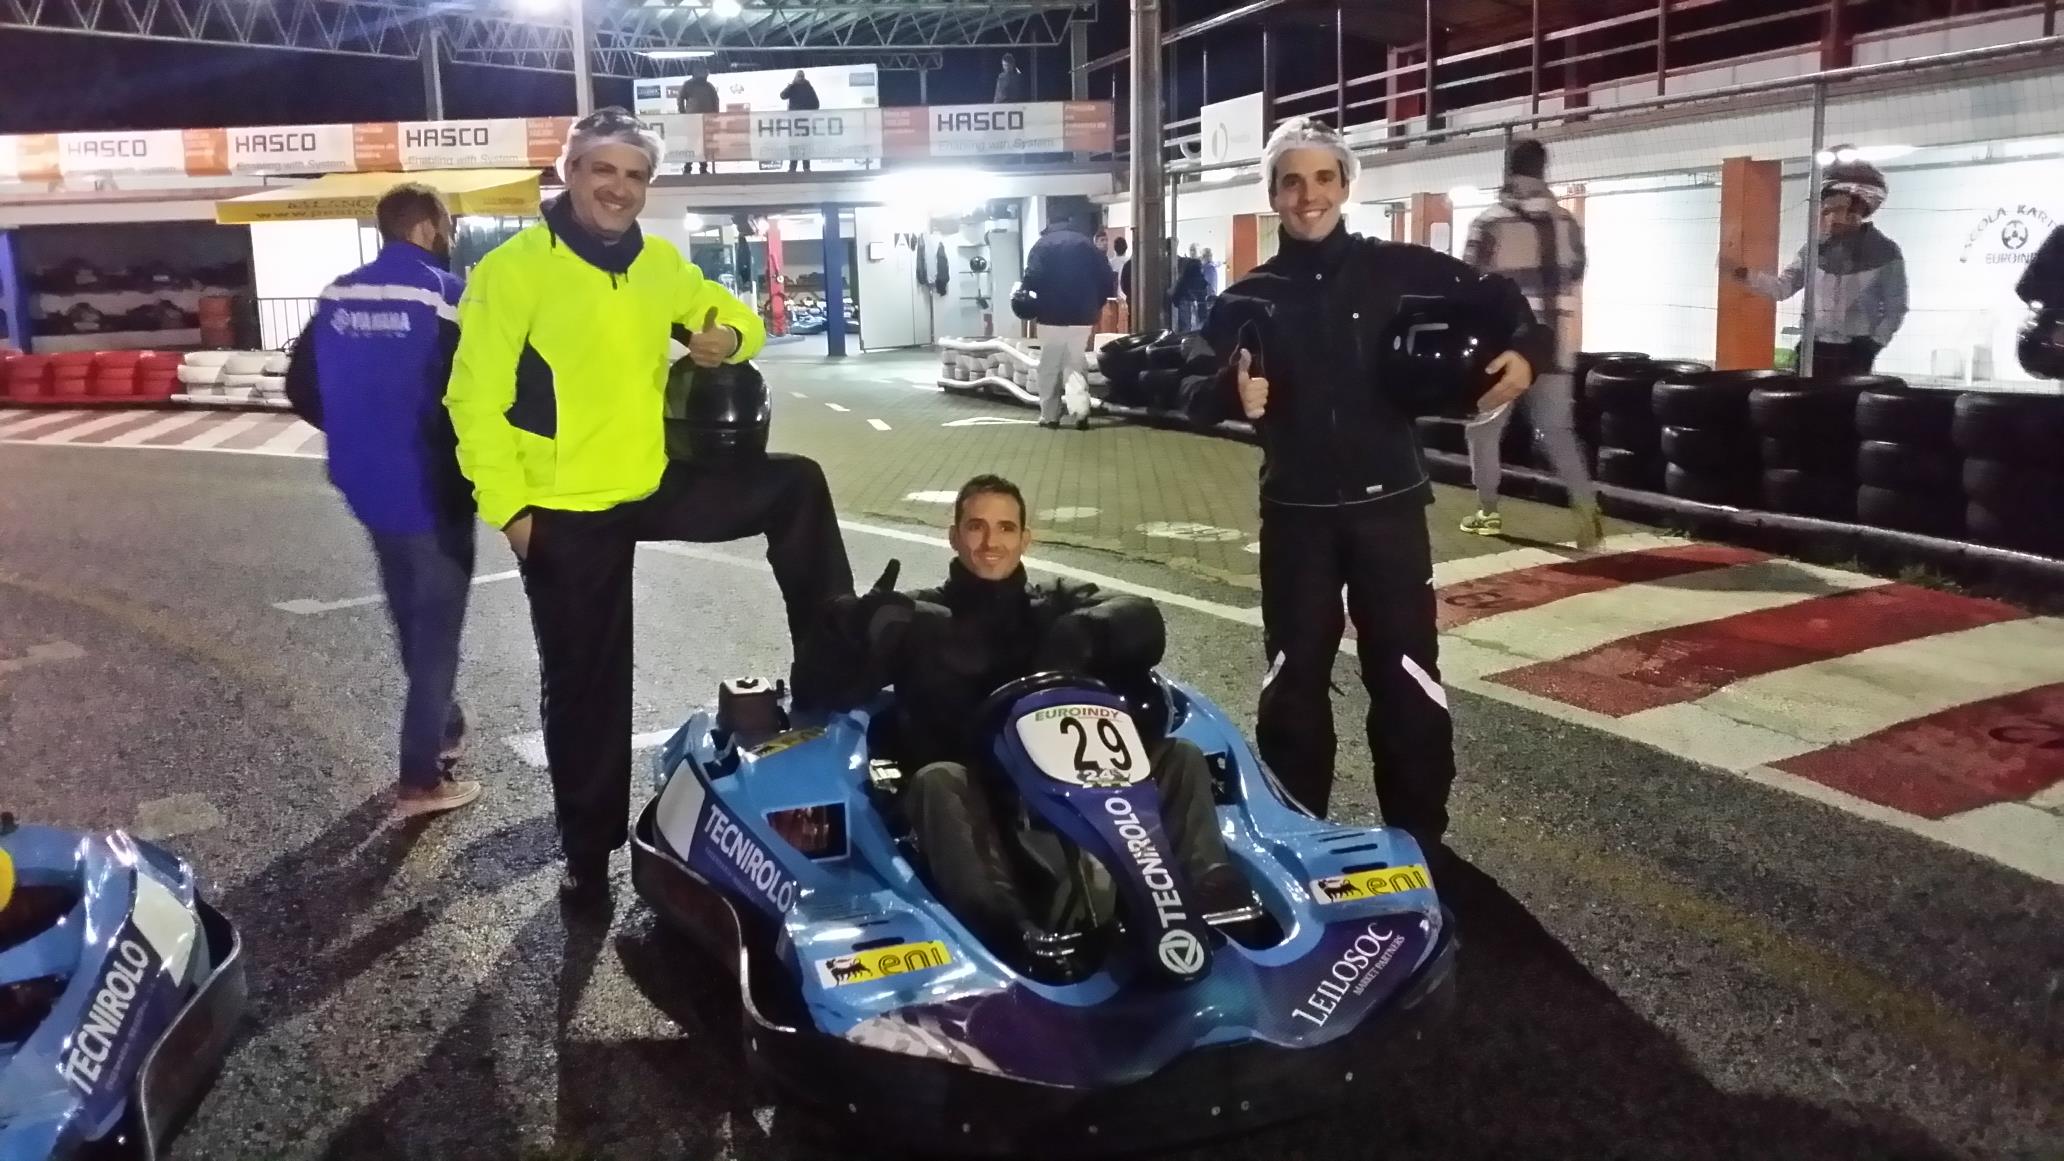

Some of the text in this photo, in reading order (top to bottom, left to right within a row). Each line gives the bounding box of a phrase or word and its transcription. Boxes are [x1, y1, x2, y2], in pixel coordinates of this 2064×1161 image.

[758, 117, 843, 137] HASCO
[936, 111, 1024, 132] HASCO
[68, 139, 147, 157] HASCO
[236, 133, 316, 152] HASCO
[406, 127, 488, 147] HASCO
[309, 159, 346, 170] System
[456, 155, 477, 165] with
[481, 154, 518, 166] System
[1035, 707, 1119, 721] EUROINDY
[1060, 717, 1132, 771] 29
[705, 804, 793, 913] TECNIROLO
[1105, 797, 1187, 929] TECNIROLO
[1366, 865, 1428, 895] eni
[878, 941, 943, 976] eni
[1353, 935, 1405, 996] MARKET PARTNERS
[1292, 922, 1393, 1027] LEILOSOC
[62, 940, 149, 1094] TECNIROLO
